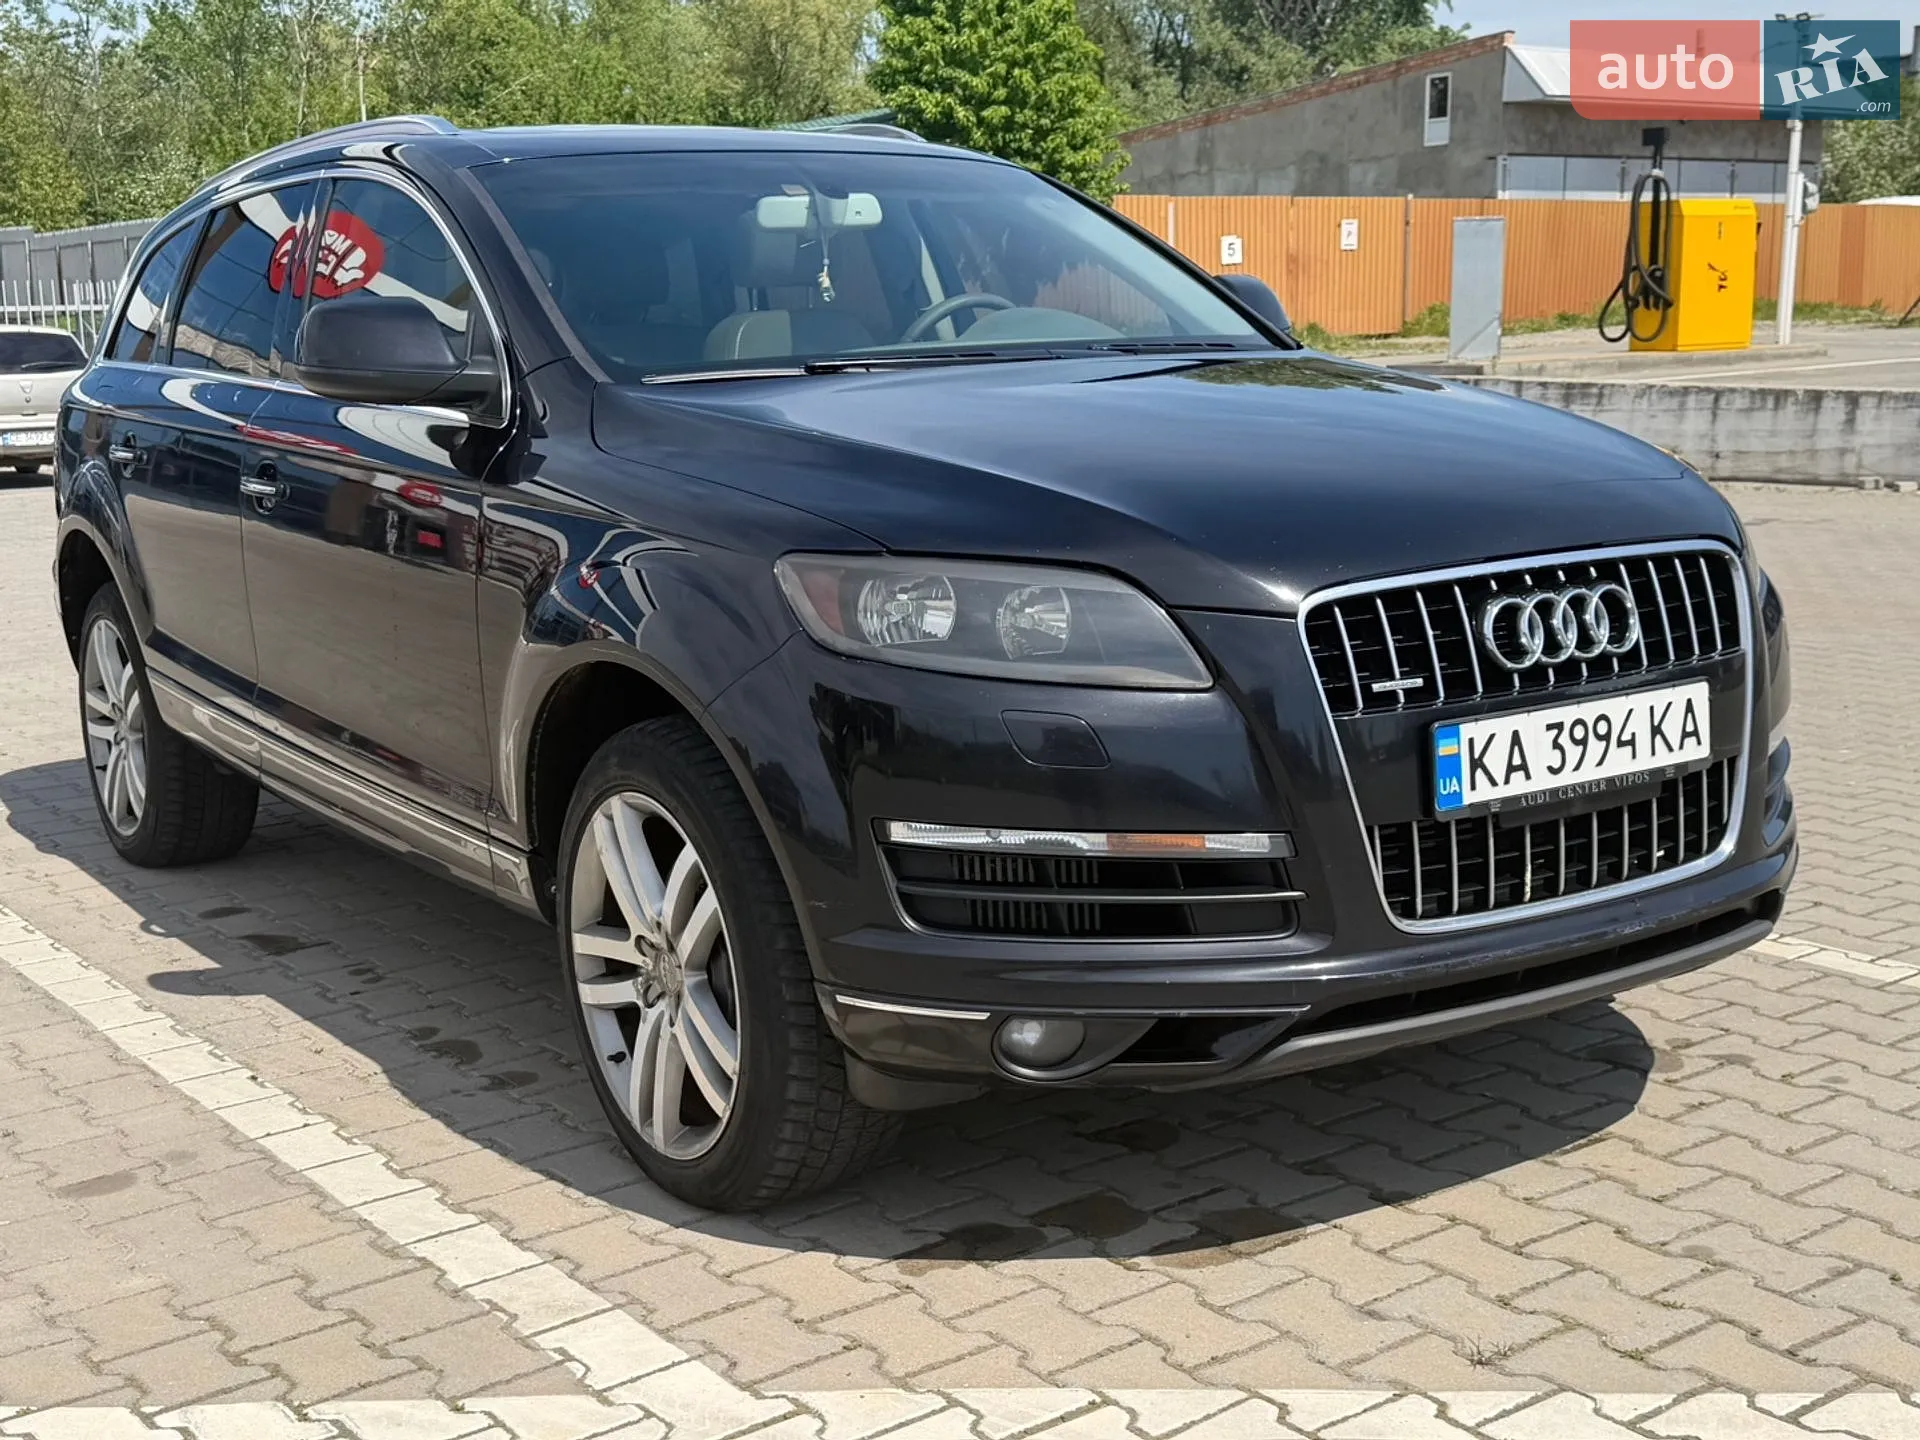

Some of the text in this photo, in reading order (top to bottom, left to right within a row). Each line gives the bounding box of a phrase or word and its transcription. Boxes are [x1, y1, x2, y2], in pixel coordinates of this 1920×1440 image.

[1227, 242, 1236, 258] 5
[1467, 697, 1702, 791] KA 3994 KA
[1439, 775, 1459, 795] UA
[1519, 791, 1550, 807] AUDI
[1558, 780, 1607, 799] CENTER
[1614, 771, 1650, 788] VIPOS
